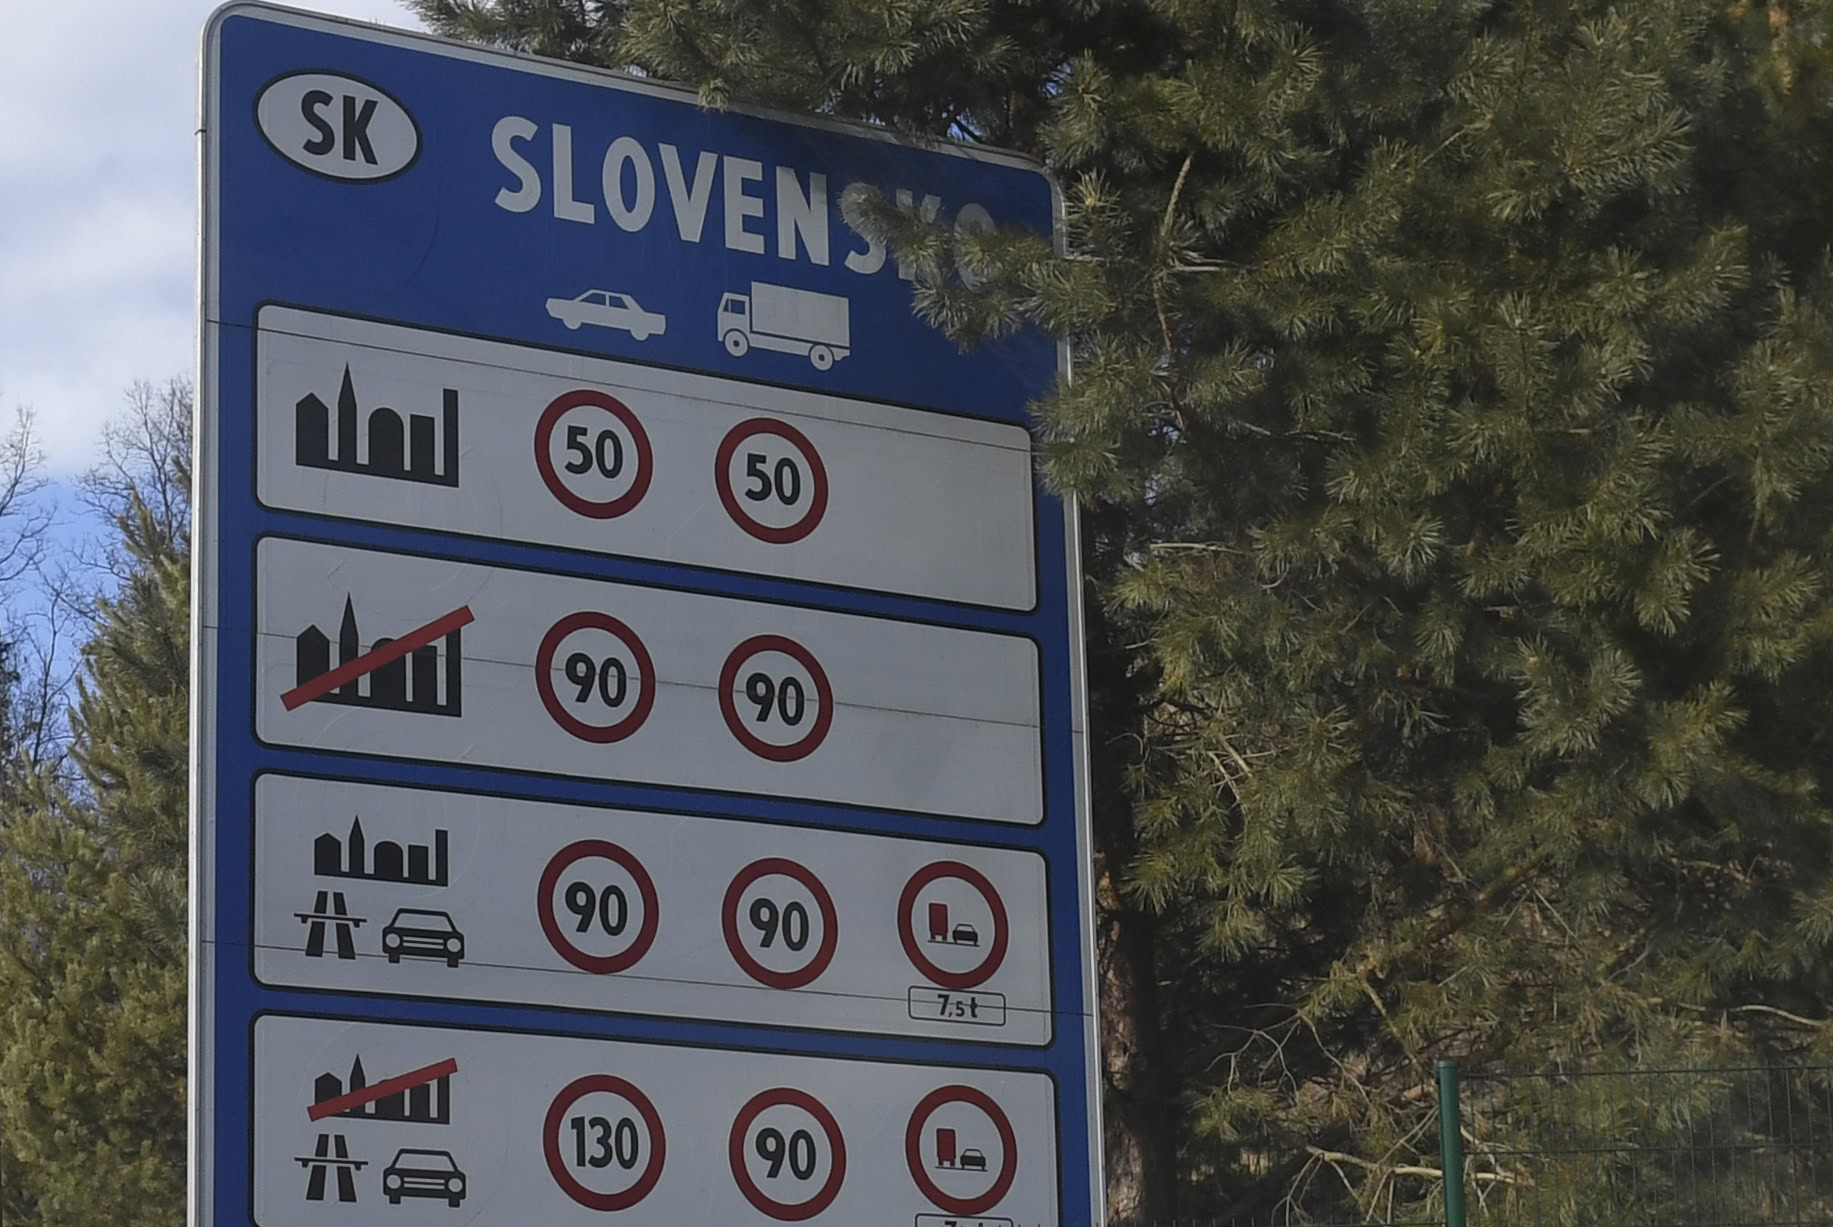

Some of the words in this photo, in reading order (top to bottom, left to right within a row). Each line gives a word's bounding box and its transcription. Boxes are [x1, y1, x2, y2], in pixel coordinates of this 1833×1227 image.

[301, 89, 379, 166] SK
[564, 424, 624, 479] 50
[744, 452, 801, 506] 50
[564, 652, 627, 708] 90
[745, 672, 805, 727] 90
[564, 881, 628, 937] 90
[749, 897, 810, 952] 90
[570, 1115, 639, 1170] 130
[755, 1127, 817, 1181] 90
